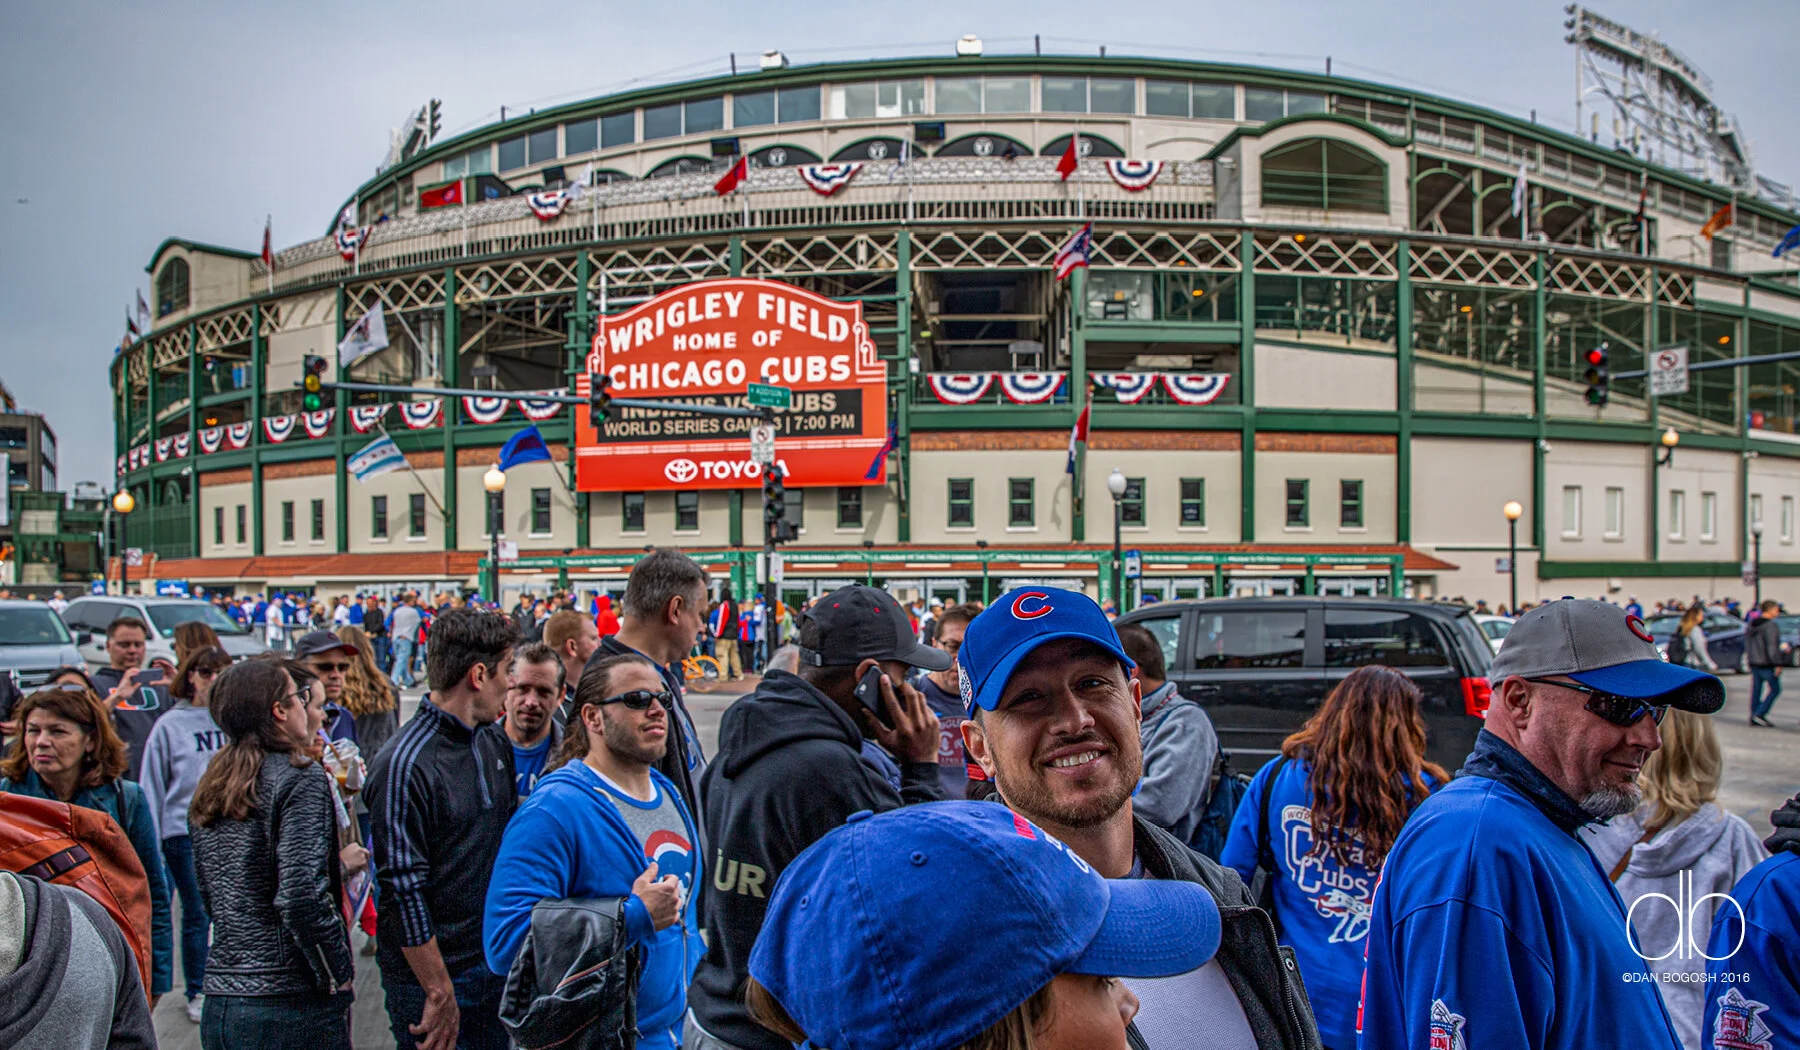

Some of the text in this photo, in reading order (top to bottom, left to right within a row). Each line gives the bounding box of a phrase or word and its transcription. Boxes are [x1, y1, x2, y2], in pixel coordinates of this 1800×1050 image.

[609, 291, 849, 354] WRIGLEY FIELD
[672, 329, 783, 351] HOME OF
[609, 354, 850, 390] CHICAGO CUBS
[771, 392, 837, 414] UBS
[604, 420, 661, 437] WORLD
[663, 417, 720, 435] SERIES
[723, 416, 765, 433] GAM
[773, 416, 783, 431] 3
[794, 414, 827, 430] 7:00
[830, 413, 855, 429] PM
[699, 459, 791, 479] TOYOA
[1011, 591, 1054, 620] C
[1298, 855, 1370, 899] Cubs
